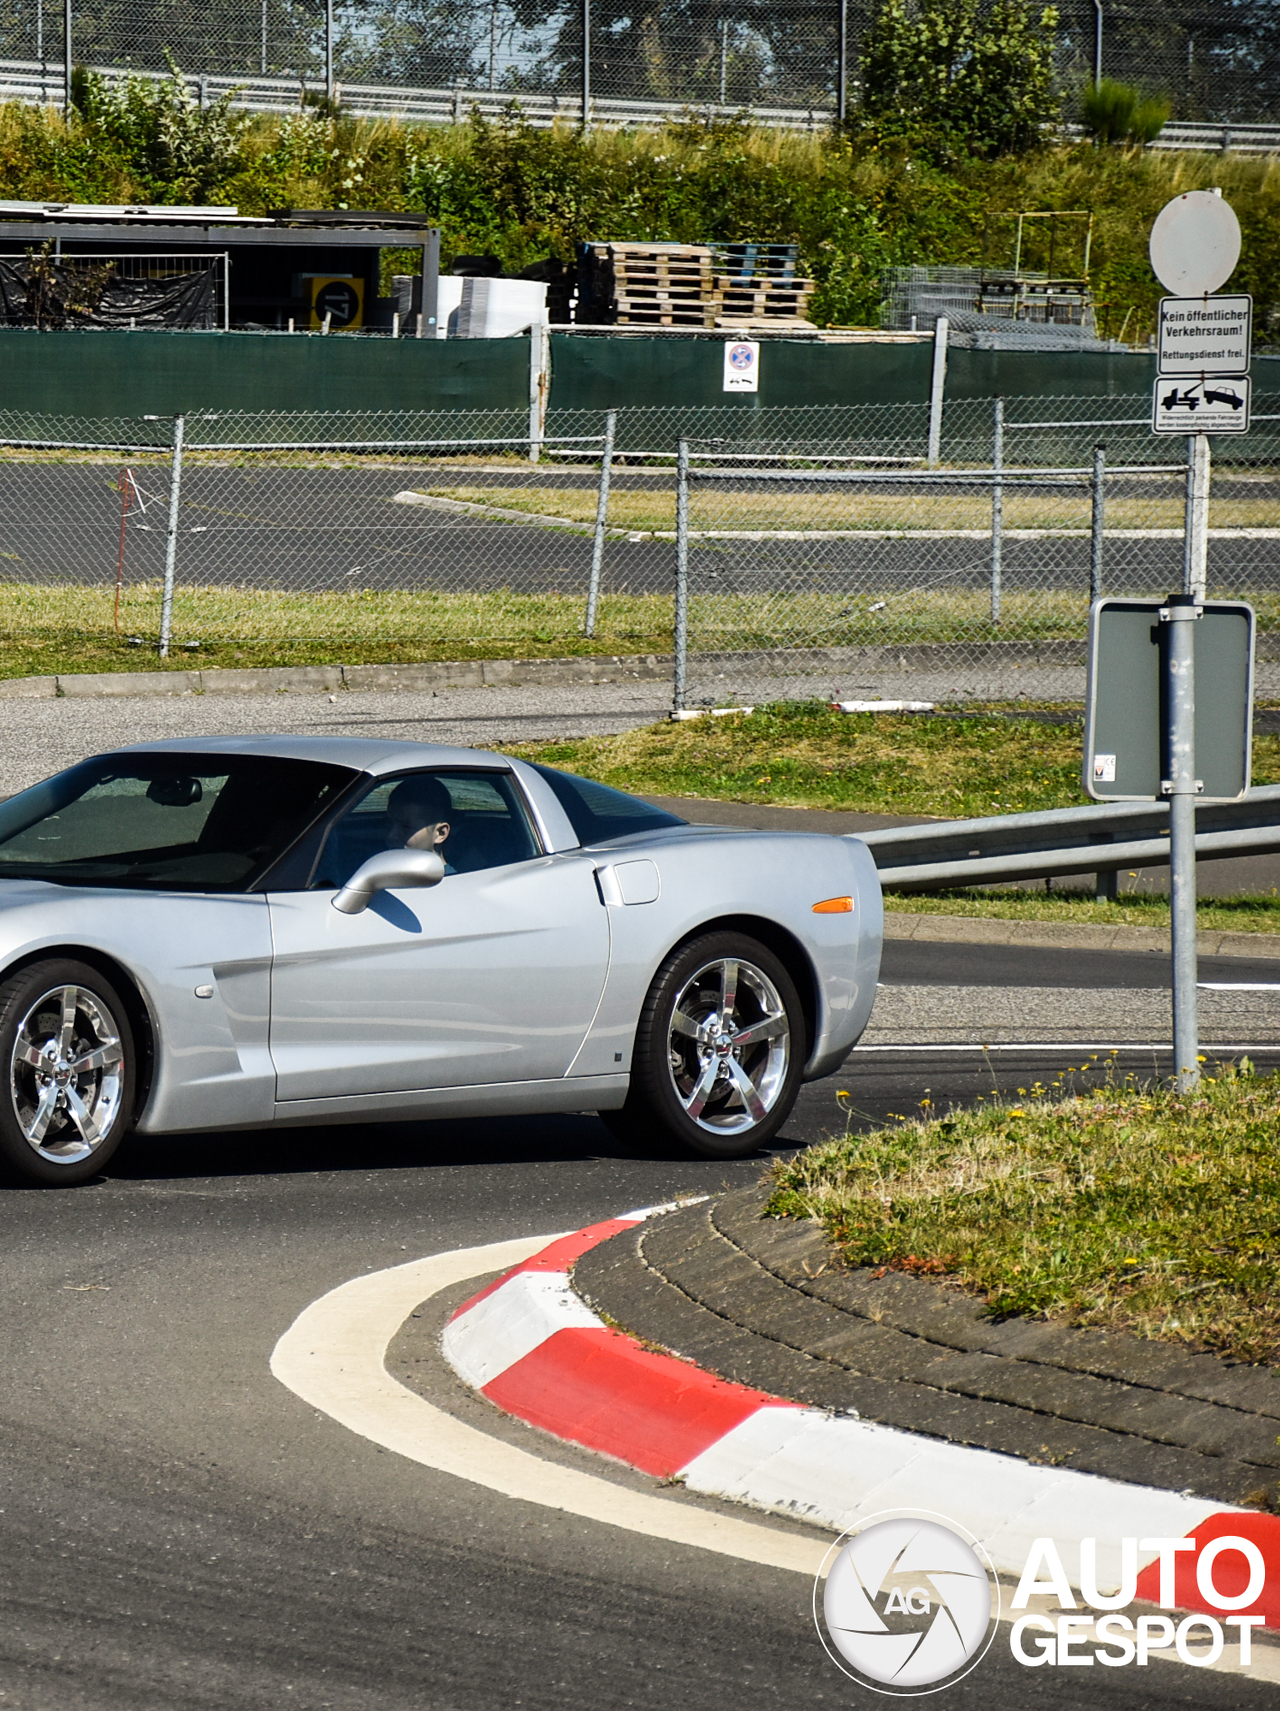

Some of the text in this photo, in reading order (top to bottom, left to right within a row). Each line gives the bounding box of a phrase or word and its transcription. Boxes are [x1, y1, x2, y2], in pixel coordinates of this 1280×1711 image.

[1163, 309, 1248, 322] Kein öffentlicher
[1166, 325, 1243, 337] Verkehrsraum!
[1162, 349, 1245, 360] Rettungsdienst frei.
